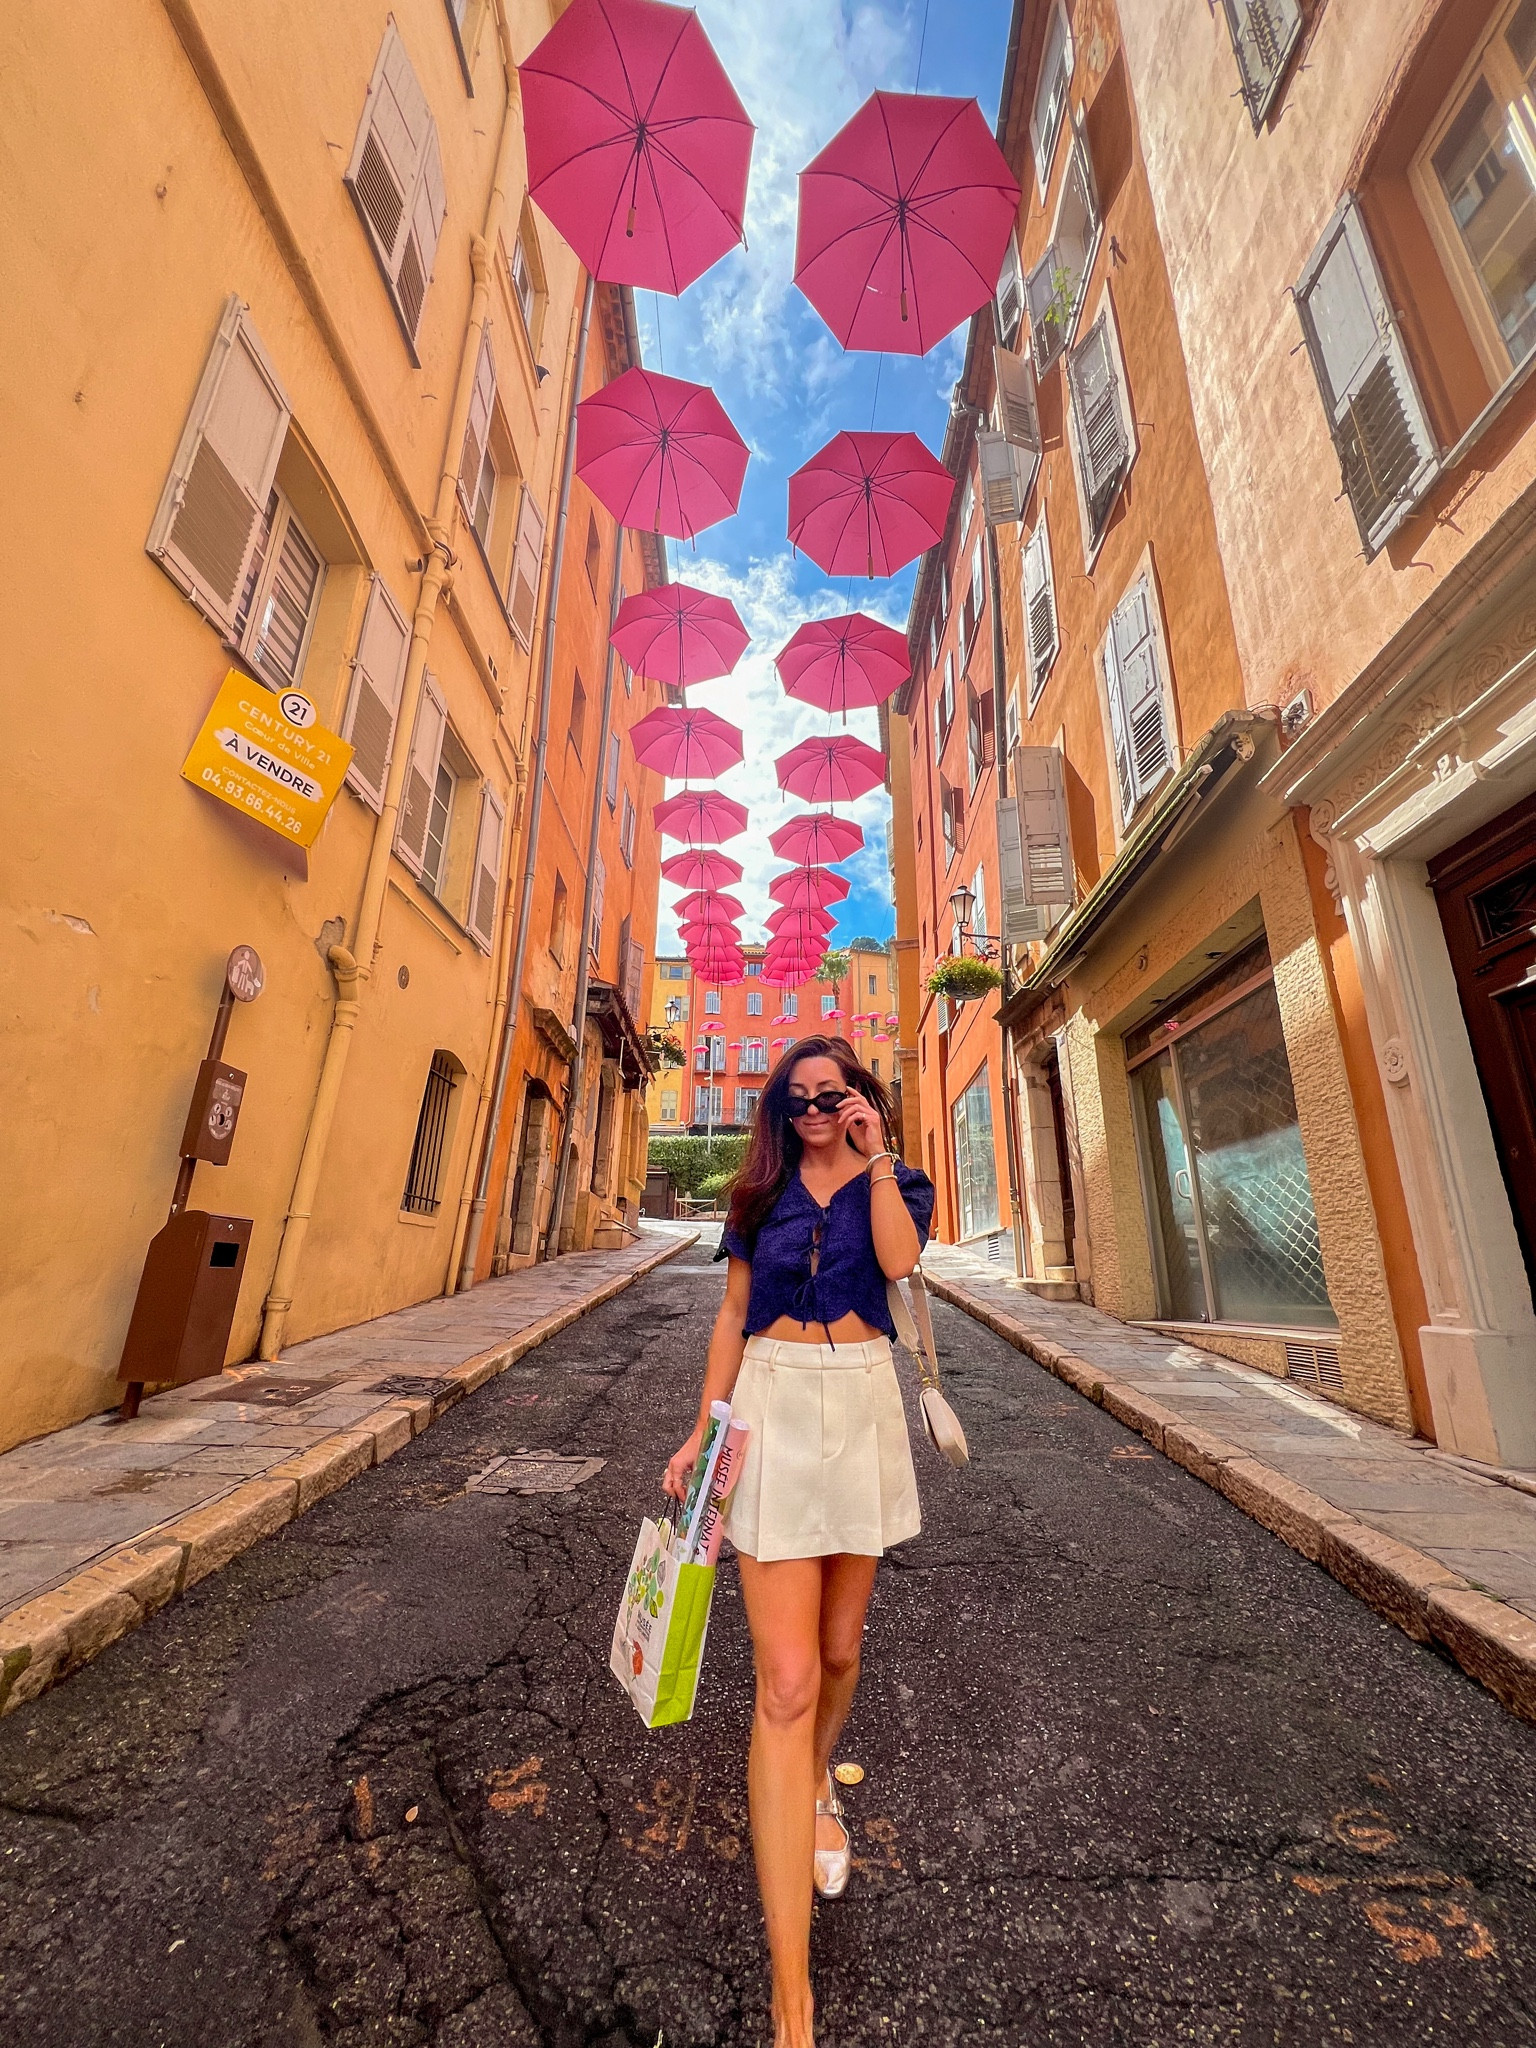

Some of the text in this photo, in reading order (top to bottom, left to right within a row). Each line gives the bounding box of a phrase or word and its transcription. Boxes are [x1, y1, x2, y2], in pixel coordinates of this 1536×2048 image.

[238, 700, 332, 766] CENTURY 21
[288, 702, 308, 721] 21
[244, 721, 276, 744] Cœur
[277, 742, 291, 755] de
[225, 733, 315, 798] À VENDRE
[201, 767, 303, 835] 04.93.66.44.26
[222, 766, 297, 815] CONTACTEZ-NOUS
[716, 1446, 733, 1488] MUSÉE
